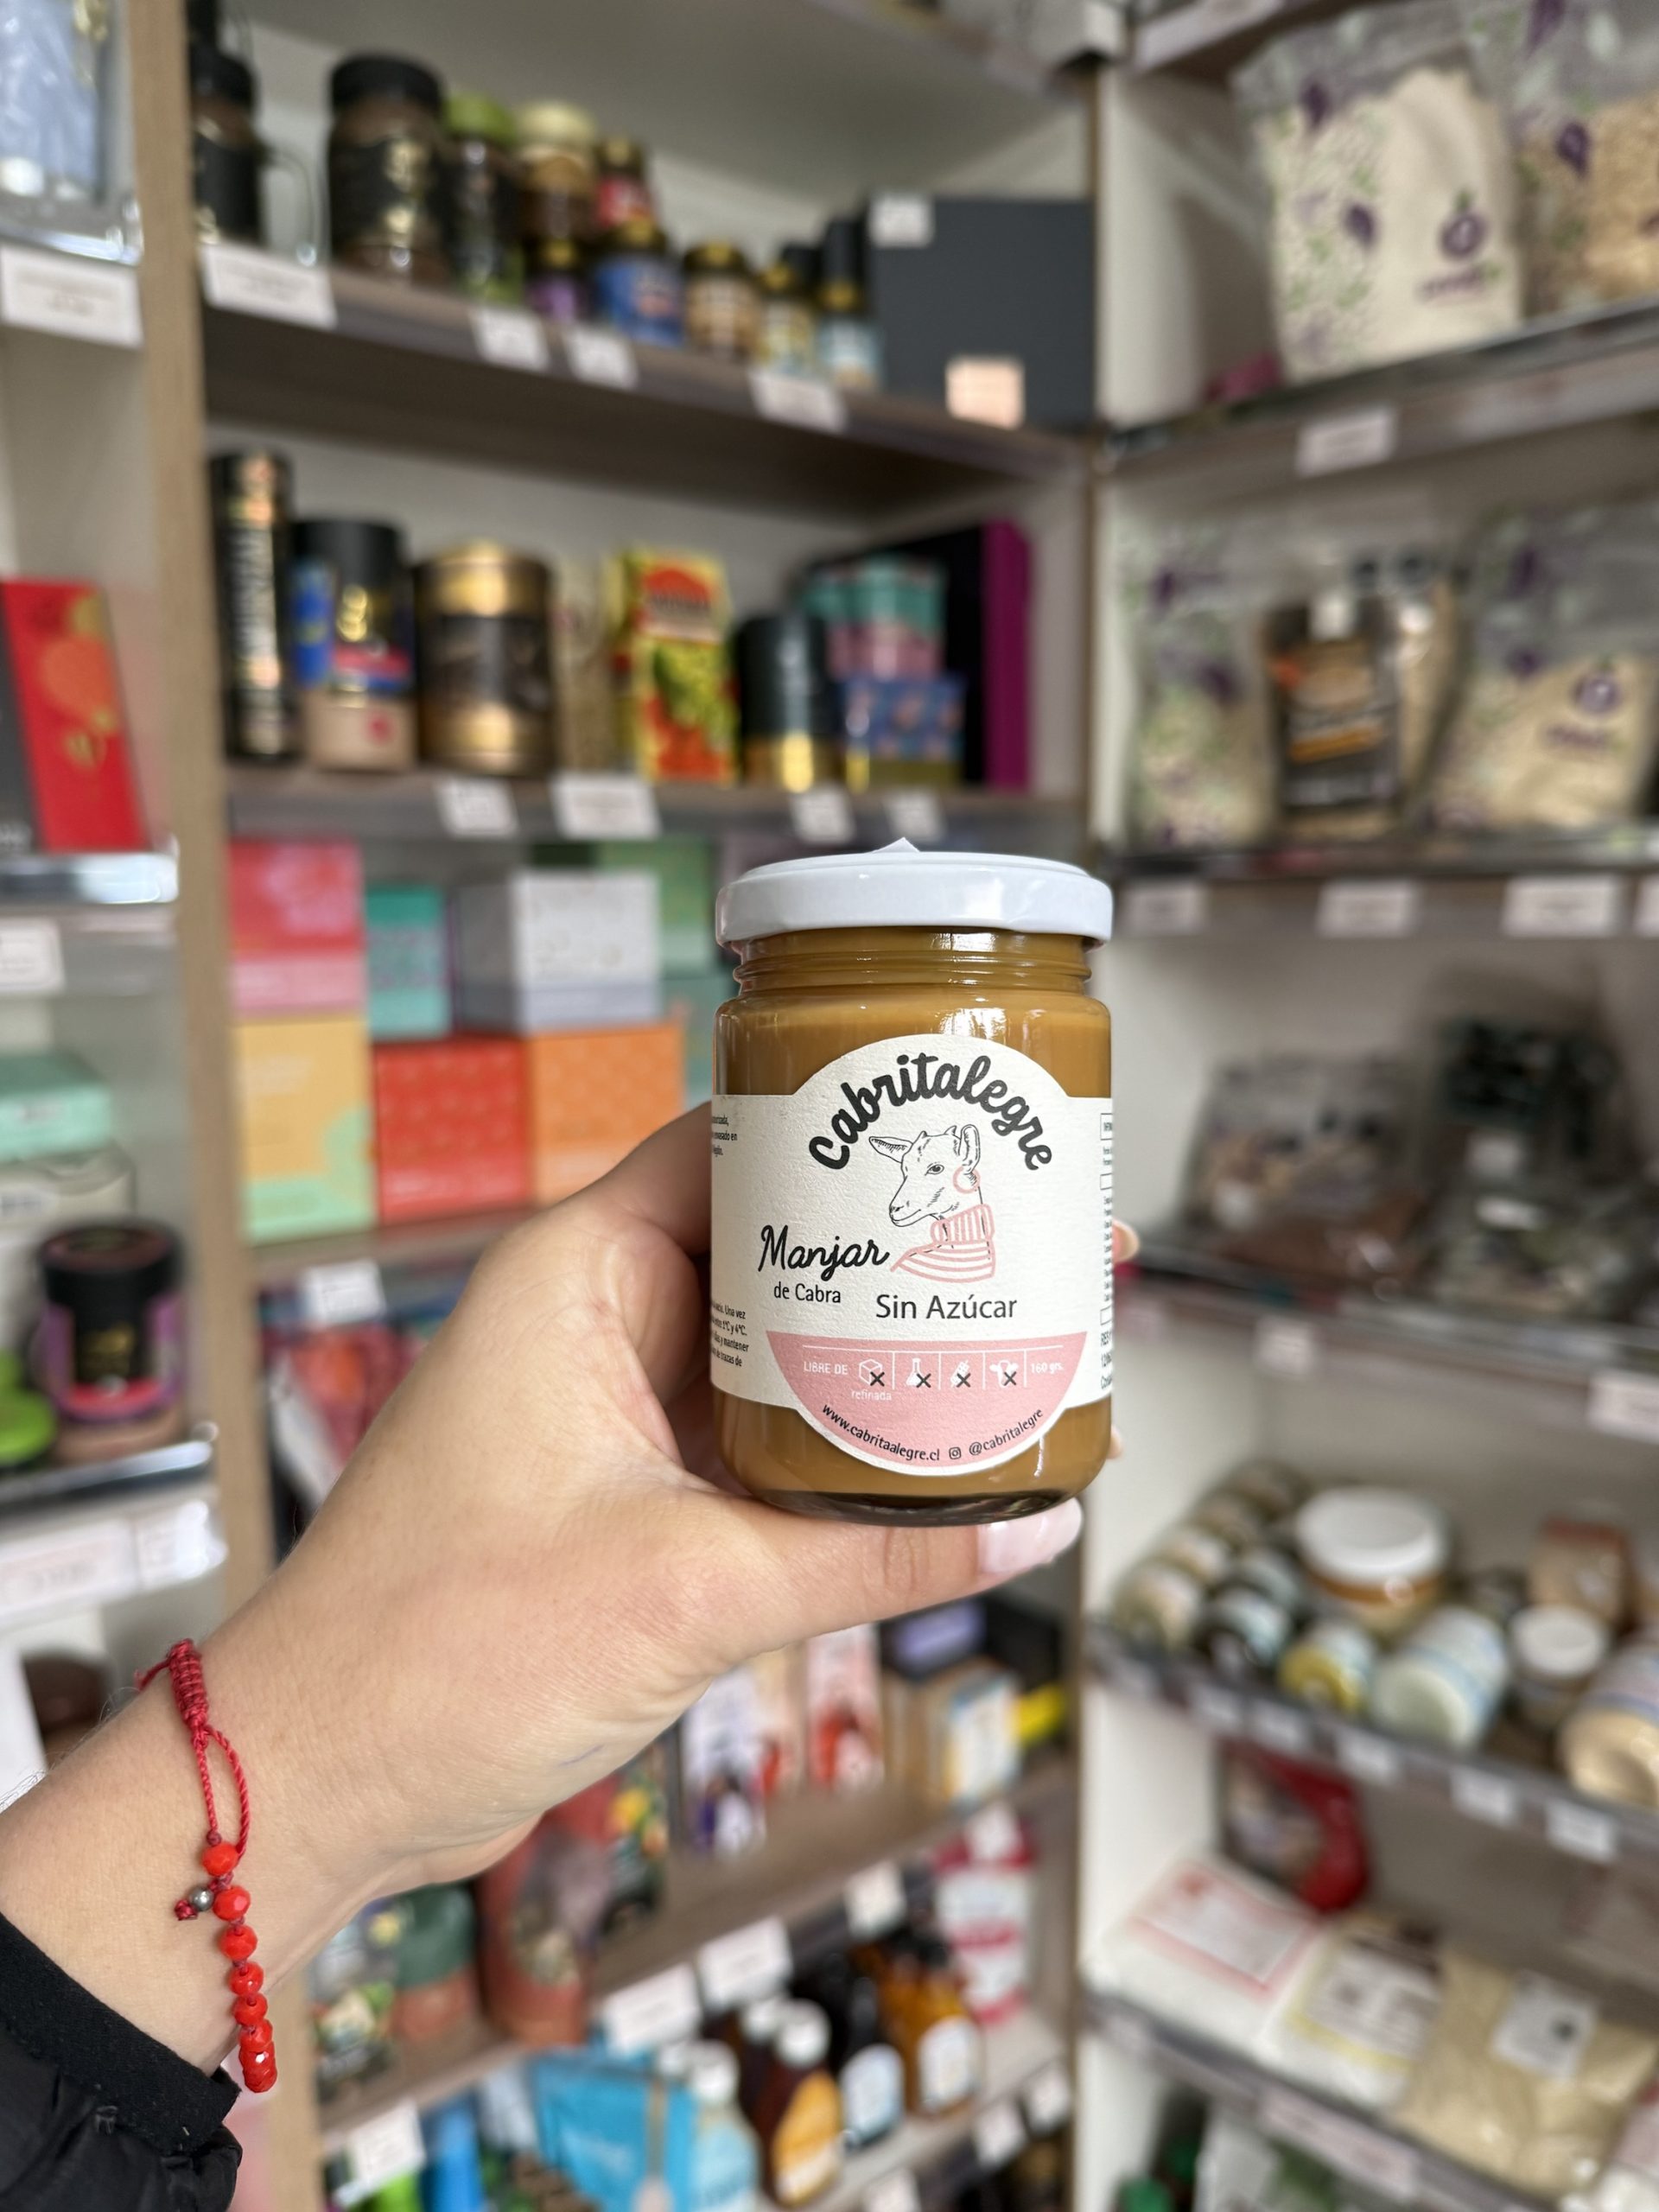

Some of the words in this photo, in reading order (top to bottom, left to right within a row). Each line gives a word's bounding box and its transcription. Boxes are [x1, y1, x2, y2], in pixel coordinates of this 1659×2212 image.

[758, 1224, 890, 1281] Manjar
[773, 1281, 790, 1300] de
[795, 1283, 842, 1303] Cabra
[735, 1309, 746, 1319] vez
[876, 1294, 917, 1319] Sin
[925, 1294, 1018, 1319] Azúcar
[735, 1354, 742, 1367] de
[804, 1361, 831, 1374] LIBRE
[834, 1363, 849, 1376] DE
[851, 1388, 893, 1401] refinada
[823, 1404, 940, 1461] www.cabritaalegre.cl
[969, 1409, 1043, 1456] @cabritalegre
